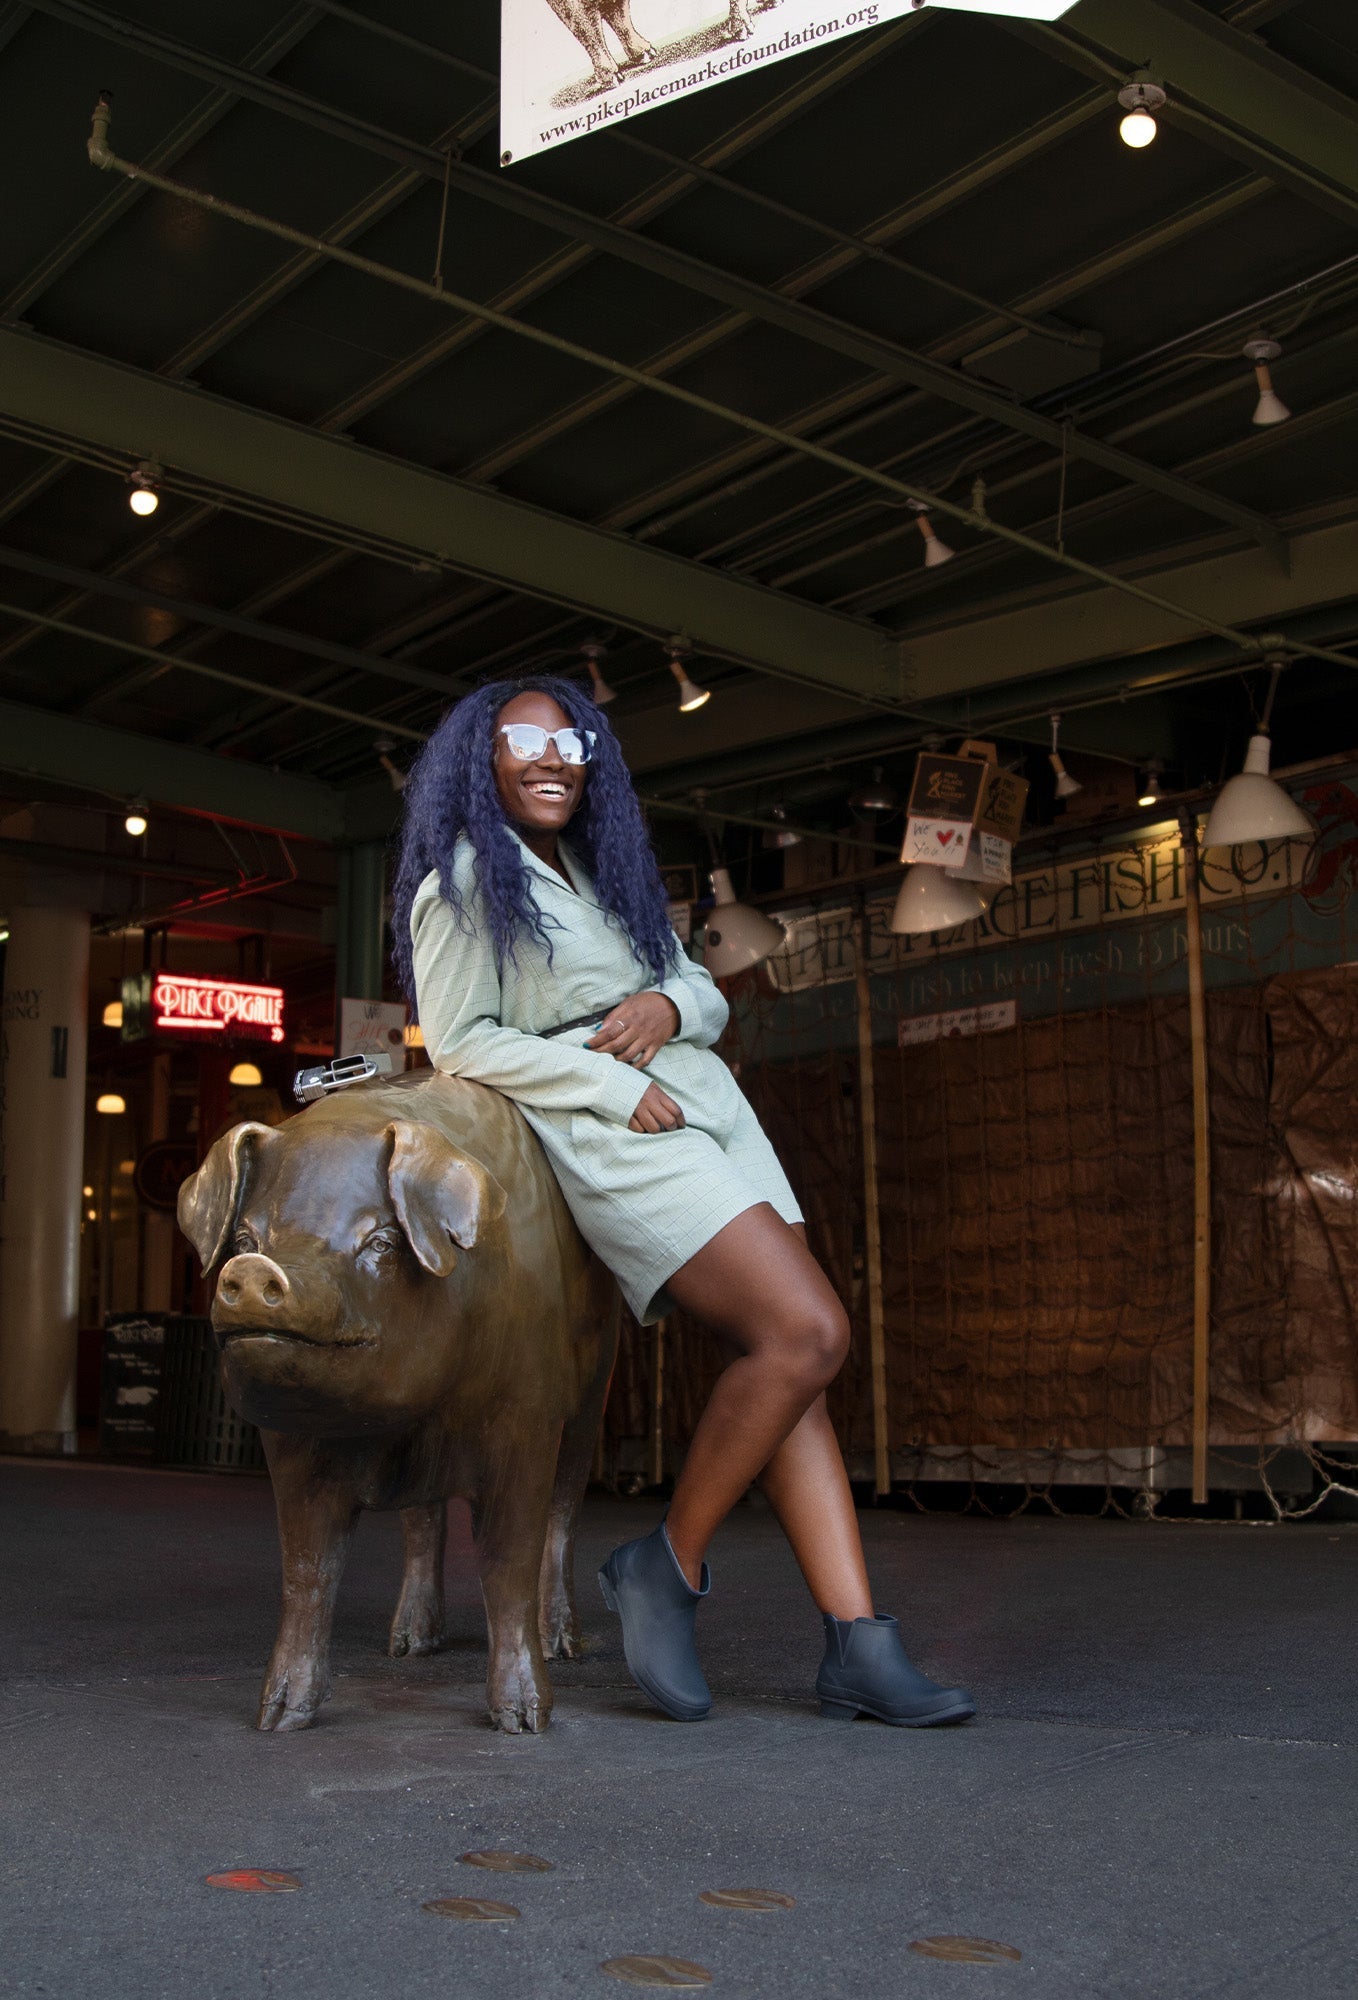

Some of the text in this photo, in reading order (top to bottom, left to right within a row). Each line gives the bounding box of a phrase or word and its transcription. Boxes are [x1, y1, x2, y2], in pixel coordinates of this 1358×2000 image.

[539, 3, 880, 143] www.pikeplacemarketfoundation.org
[796, 910, 894, 975] PIKE
[903, 875, 1057, 953] ACE
[1070, 848, 1184, 920] FISH
[960, 965, 983, 996] to
[1173, 922, 1251, 960] hurs
